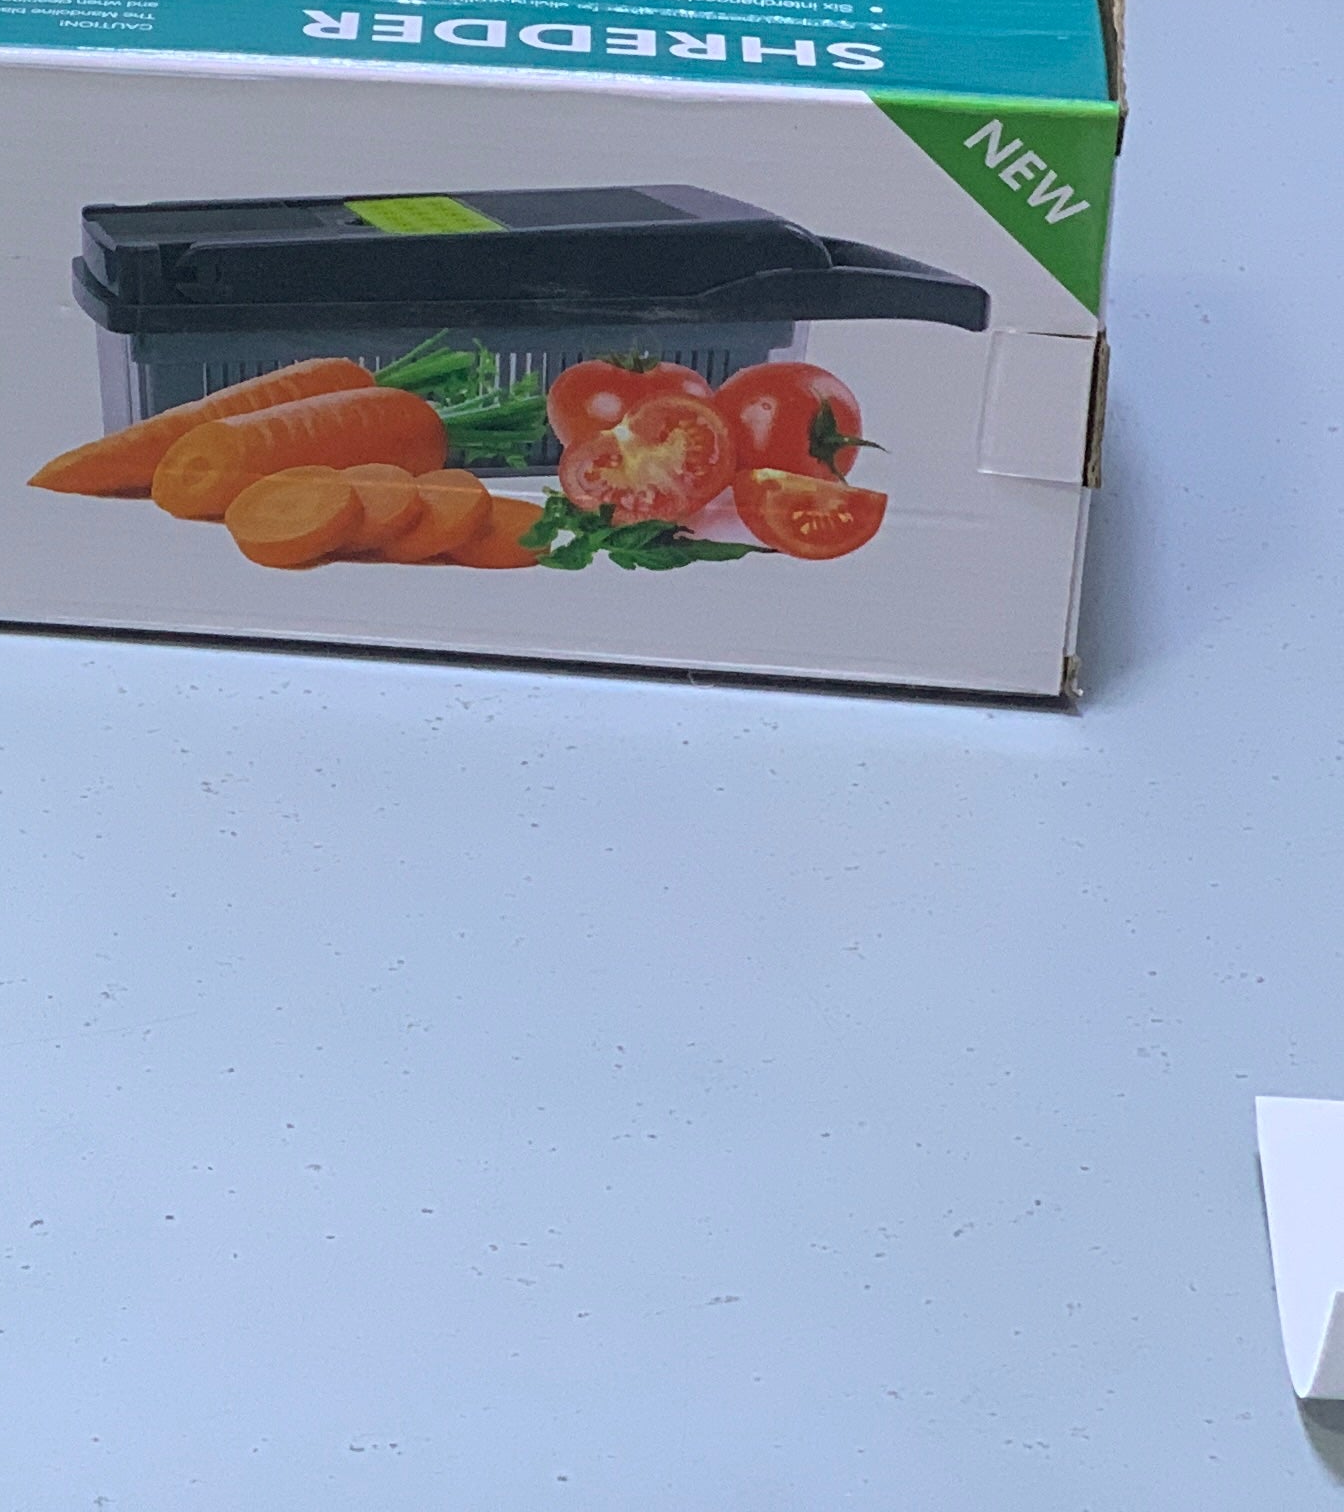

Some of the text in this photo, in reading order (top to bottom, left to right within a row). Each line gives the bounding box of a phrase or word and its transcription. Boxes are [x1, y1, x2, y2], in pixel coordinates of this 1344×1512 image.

[59, 20, 152, 29] CAUTION!
[822, 2, 853, 13] Six
[302, 9, 885, 71] SHREDDER
[963, 119, 1091, 225] NEW
